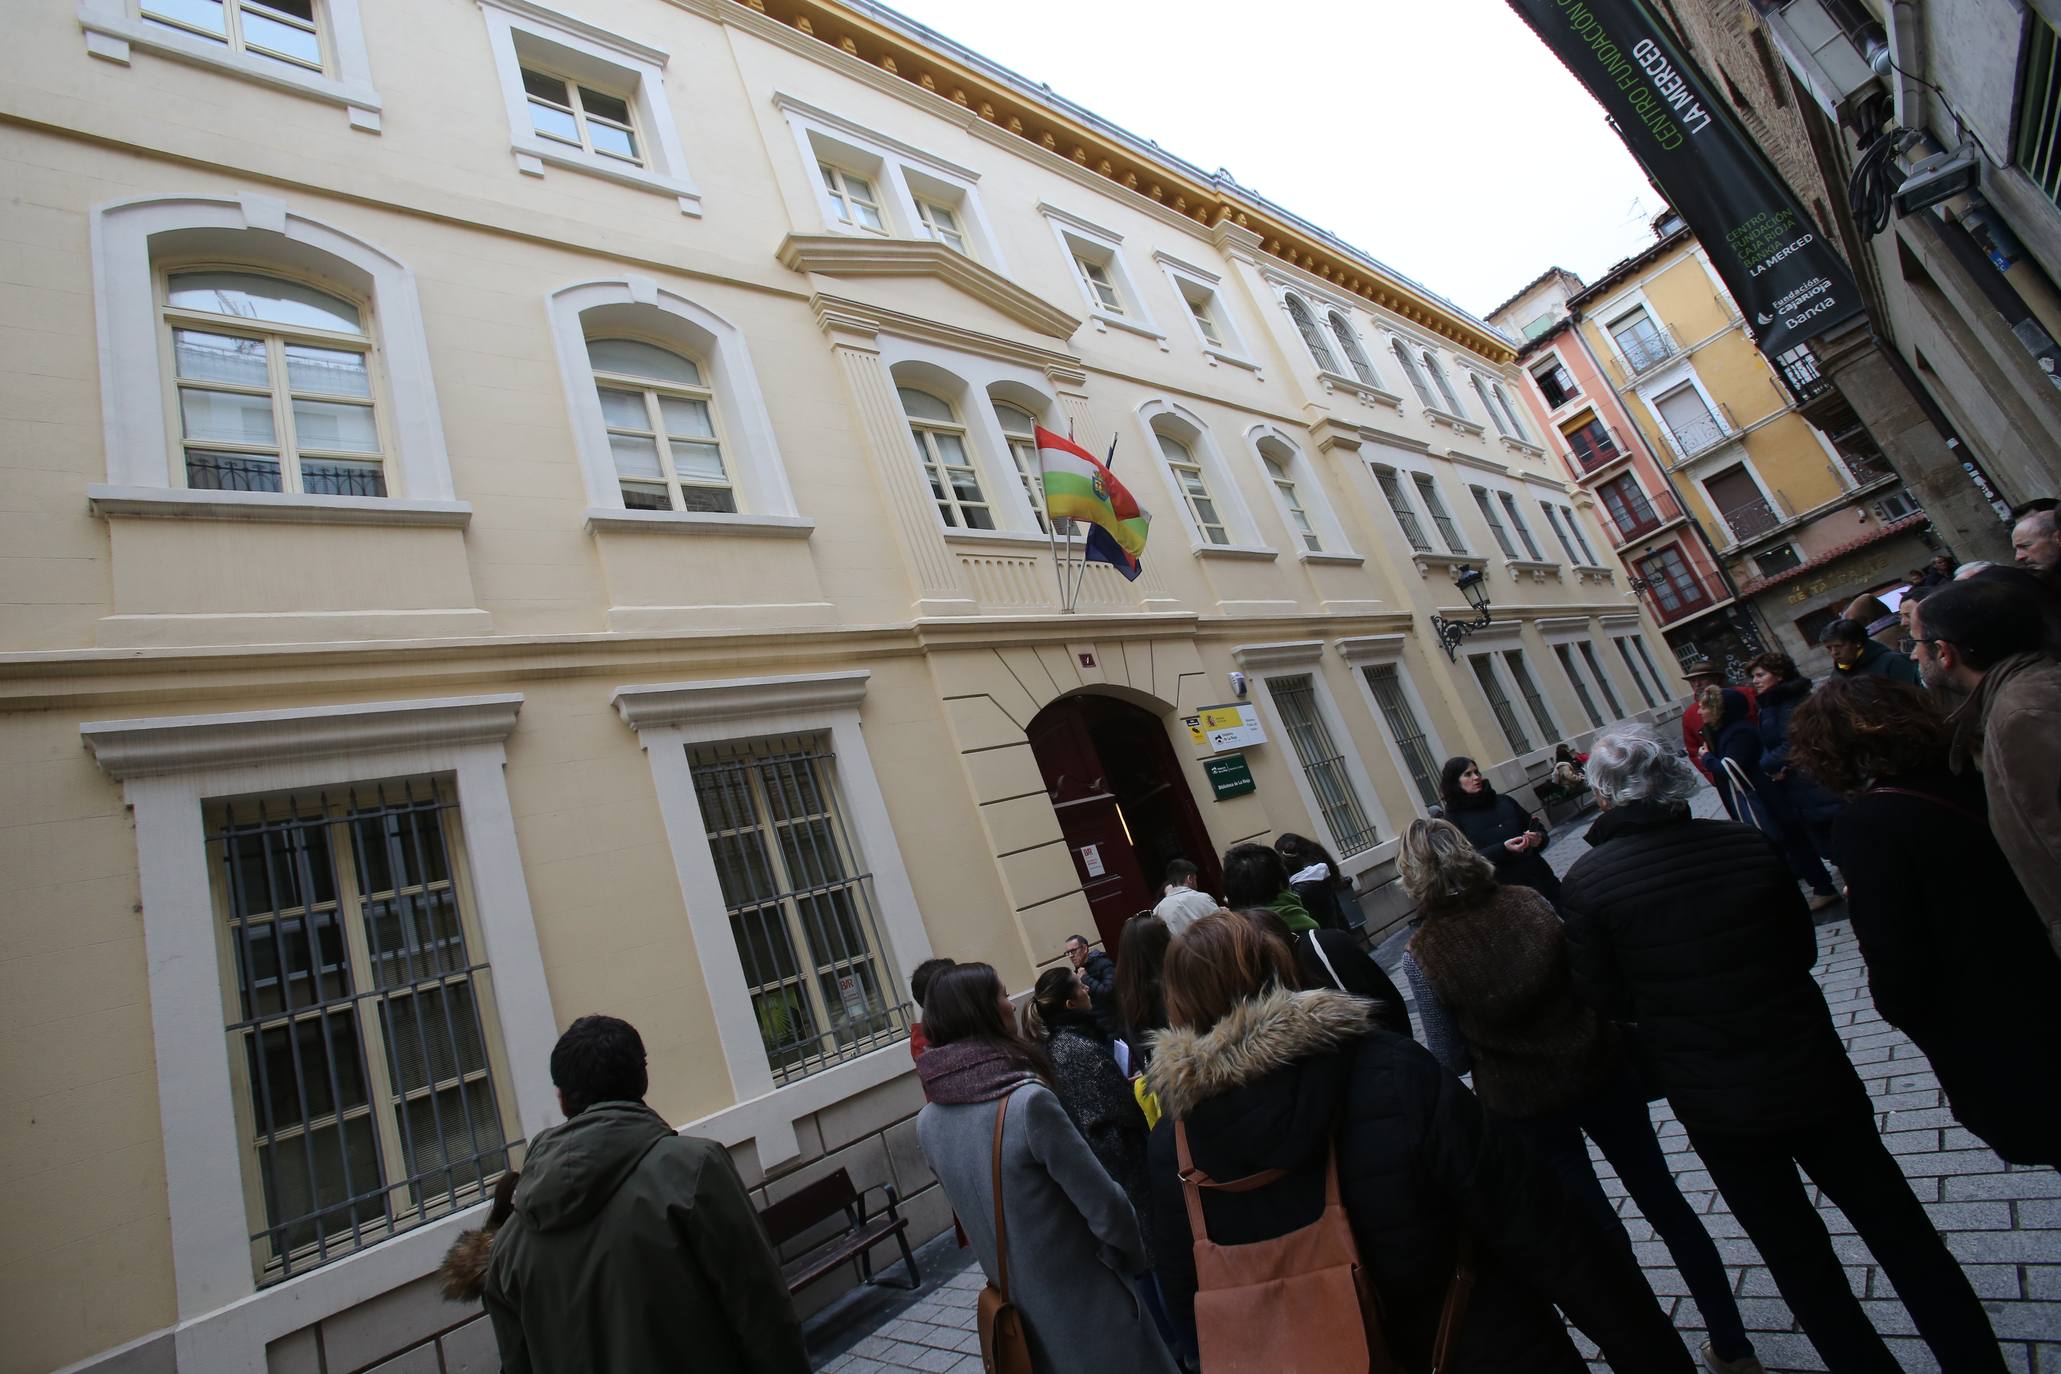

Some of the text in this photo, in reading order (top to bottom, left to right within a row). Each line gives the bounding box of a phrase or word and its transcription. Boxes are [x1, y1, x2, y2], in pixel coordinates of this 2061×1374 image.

[1565, 2, 1684, 150] CENTRO FUNDACIÓN
[1632, 38, 1712, 135] LA MERCED
[1726, 212, 1767, 242] CENTRO
[1737, 220, 1797, 260] CAJA RIOJA
[1743, 240, 1783, 268] BANKIA
[1749, 233, 1813, 277] LA MERCED
[1772, 277, 1820, 310] Fundación
[1785, 297, 1836, 330] Bankia
